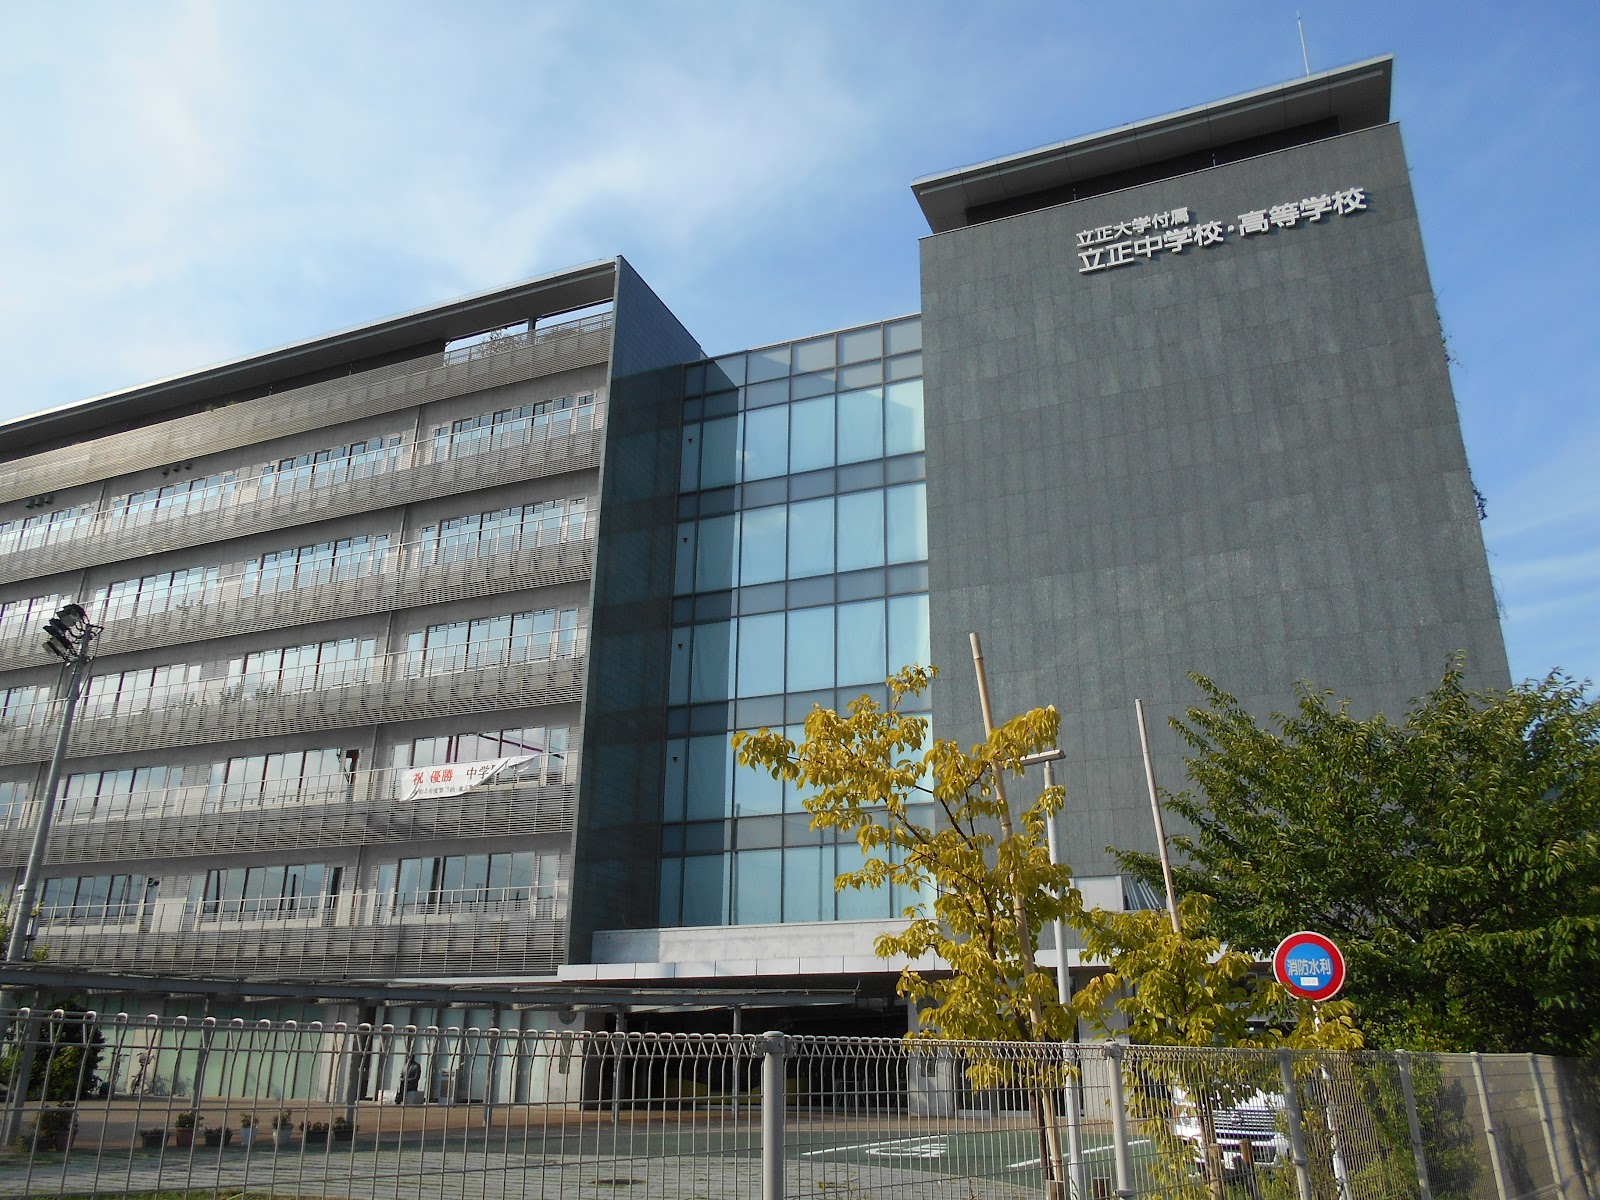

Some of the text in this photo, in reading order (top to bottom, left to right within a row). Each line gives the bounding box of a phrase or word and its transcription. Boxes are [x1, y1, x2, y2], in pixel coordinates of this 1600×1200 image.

[1076, 207, 1190, 247] 立正大学付属
[413, 772, 424, 785] 祝
[429, 769, 453, 783] 優勝
[1286, 958, 1332, 976] 消防水利
